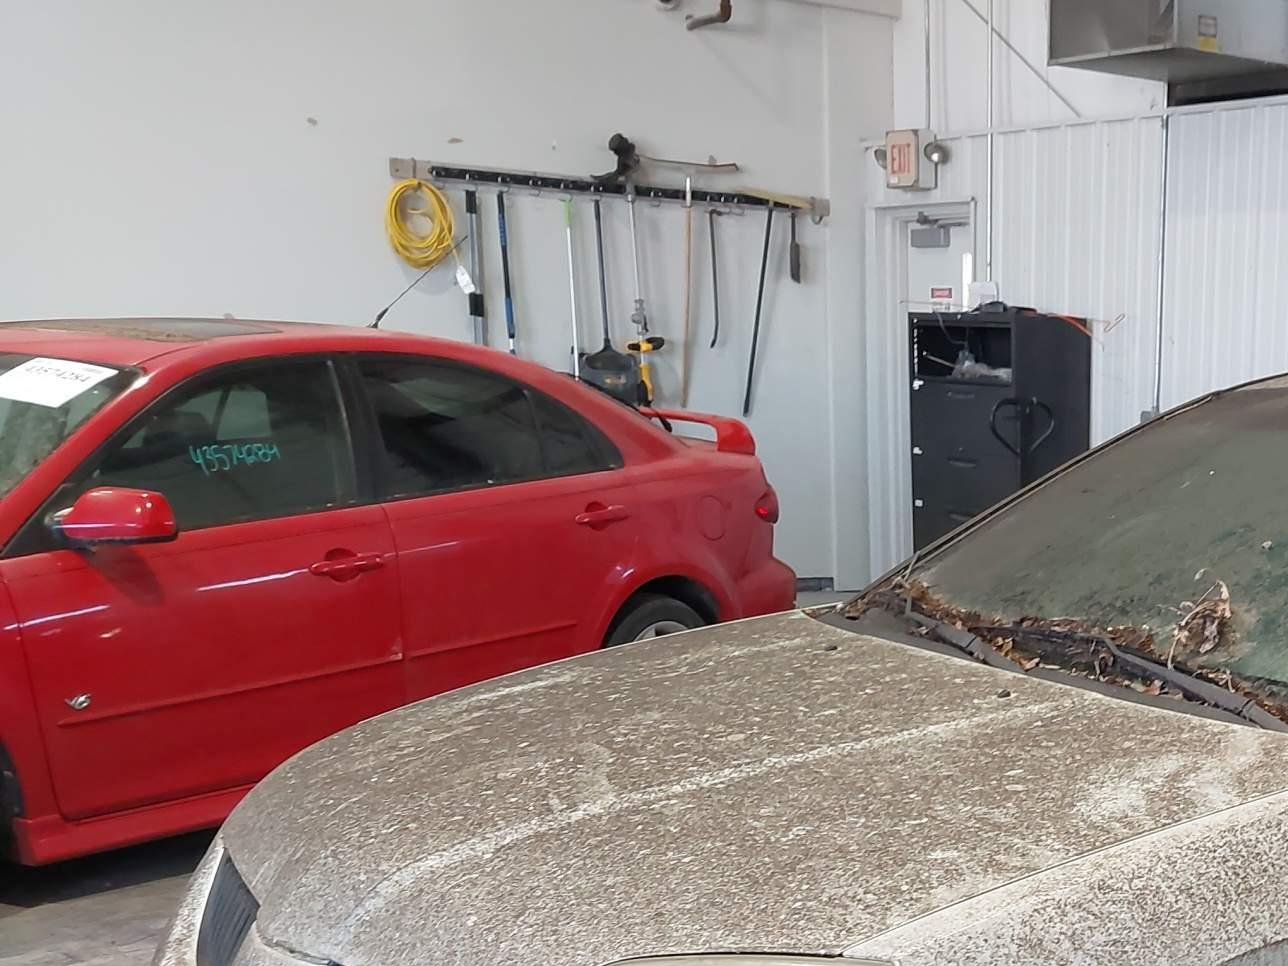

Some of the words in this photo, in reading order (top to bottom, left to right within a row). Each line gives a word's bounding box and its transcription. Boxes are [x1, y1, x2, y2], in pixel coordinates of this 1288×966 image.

[890, 143, 911, 175] EXIT
[189, 443, 281, 476] 43574284
[64, 693, 91, 710] V6
